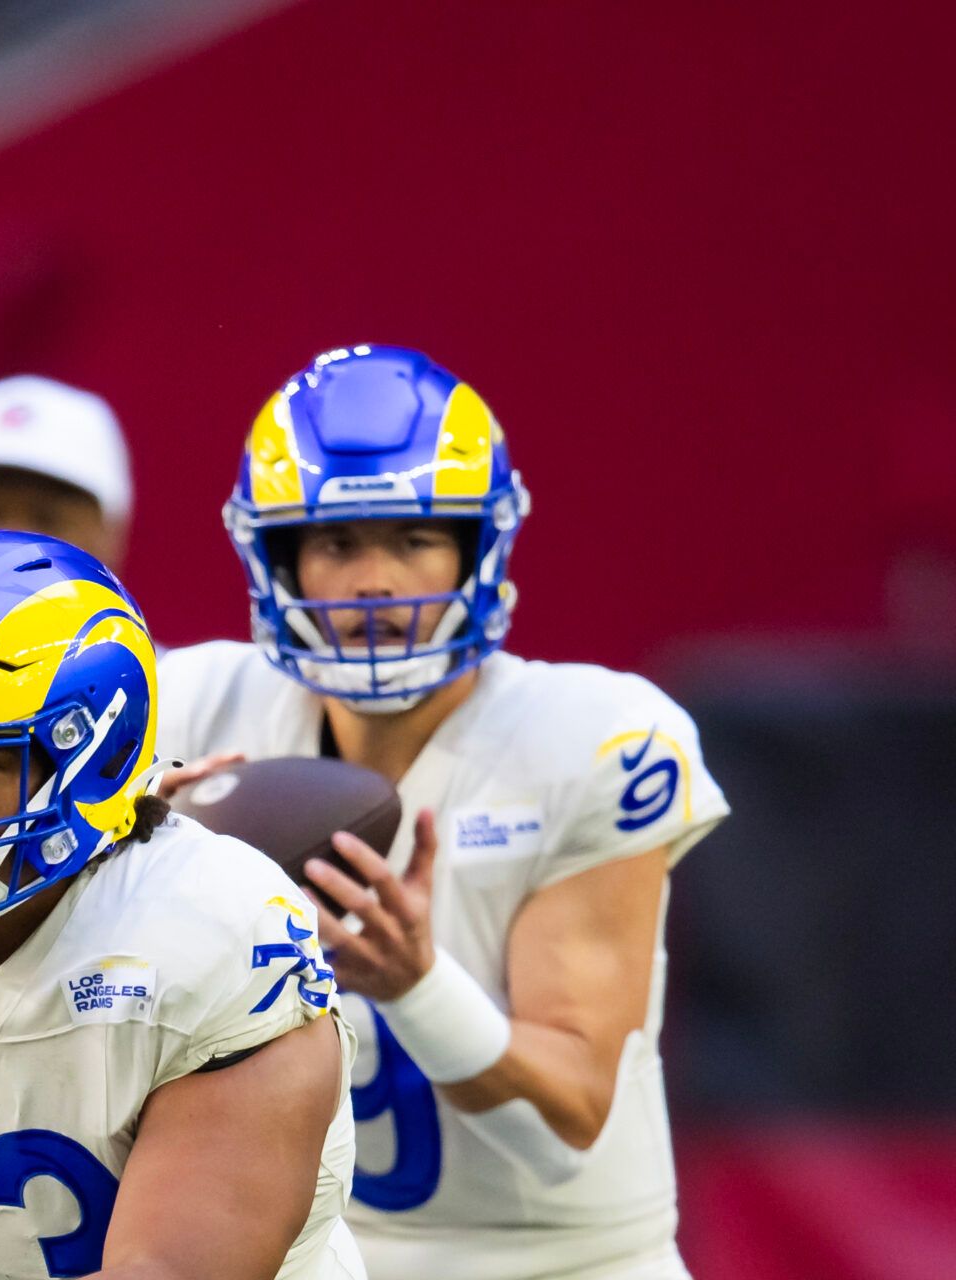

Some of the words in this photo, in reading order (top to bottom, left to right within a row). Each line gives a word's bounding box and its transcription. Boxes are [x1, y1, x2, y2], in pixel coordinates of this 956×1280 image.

[616, 758, 678, 832] 9
[69, 973, 104, 991] LOS
[73, 985, 147, 1002] ANGELES
[75, 997, 113, 1013] RAMS
